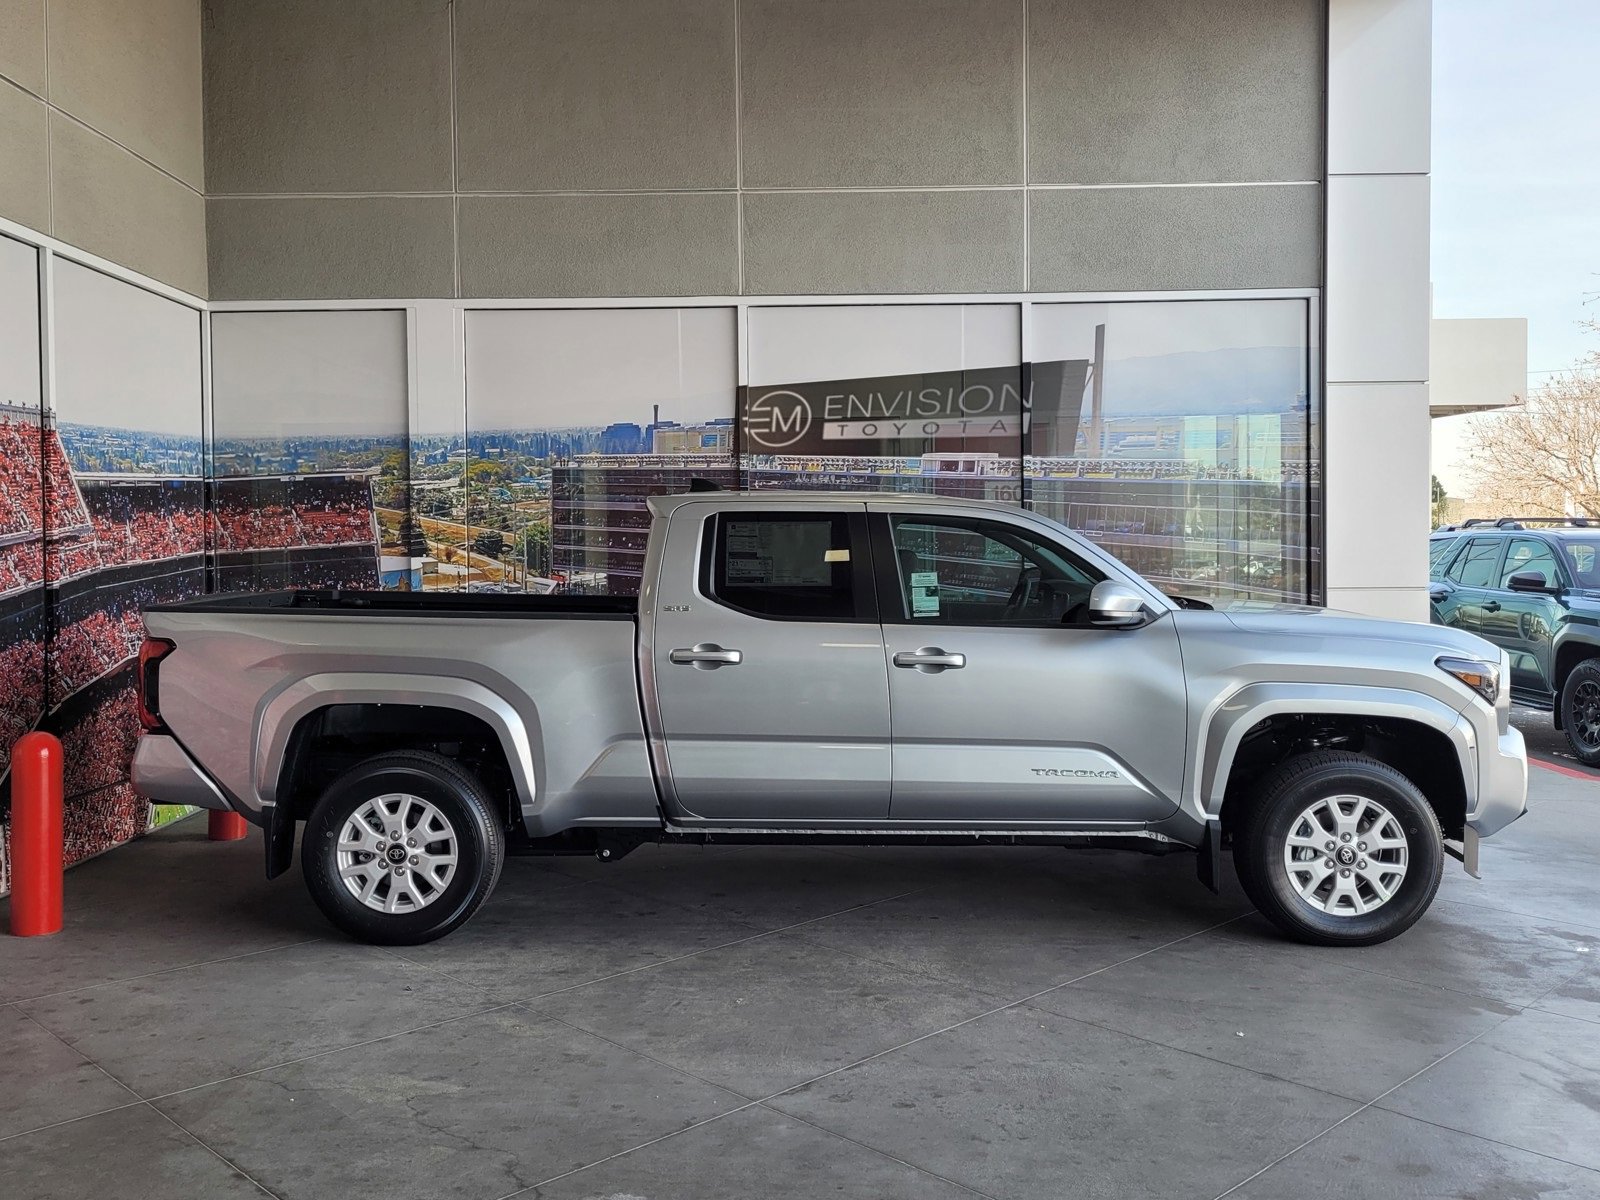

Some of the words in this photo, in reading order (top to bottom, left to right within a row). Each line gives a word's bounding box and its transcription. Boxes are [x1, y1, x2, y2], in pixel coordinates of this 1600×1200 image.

[824, 381, 1034, 419] ENVISION
[837, 419, 1008, 437] TOYOTA
[1030, 768, 1120, 779] TACOMA
